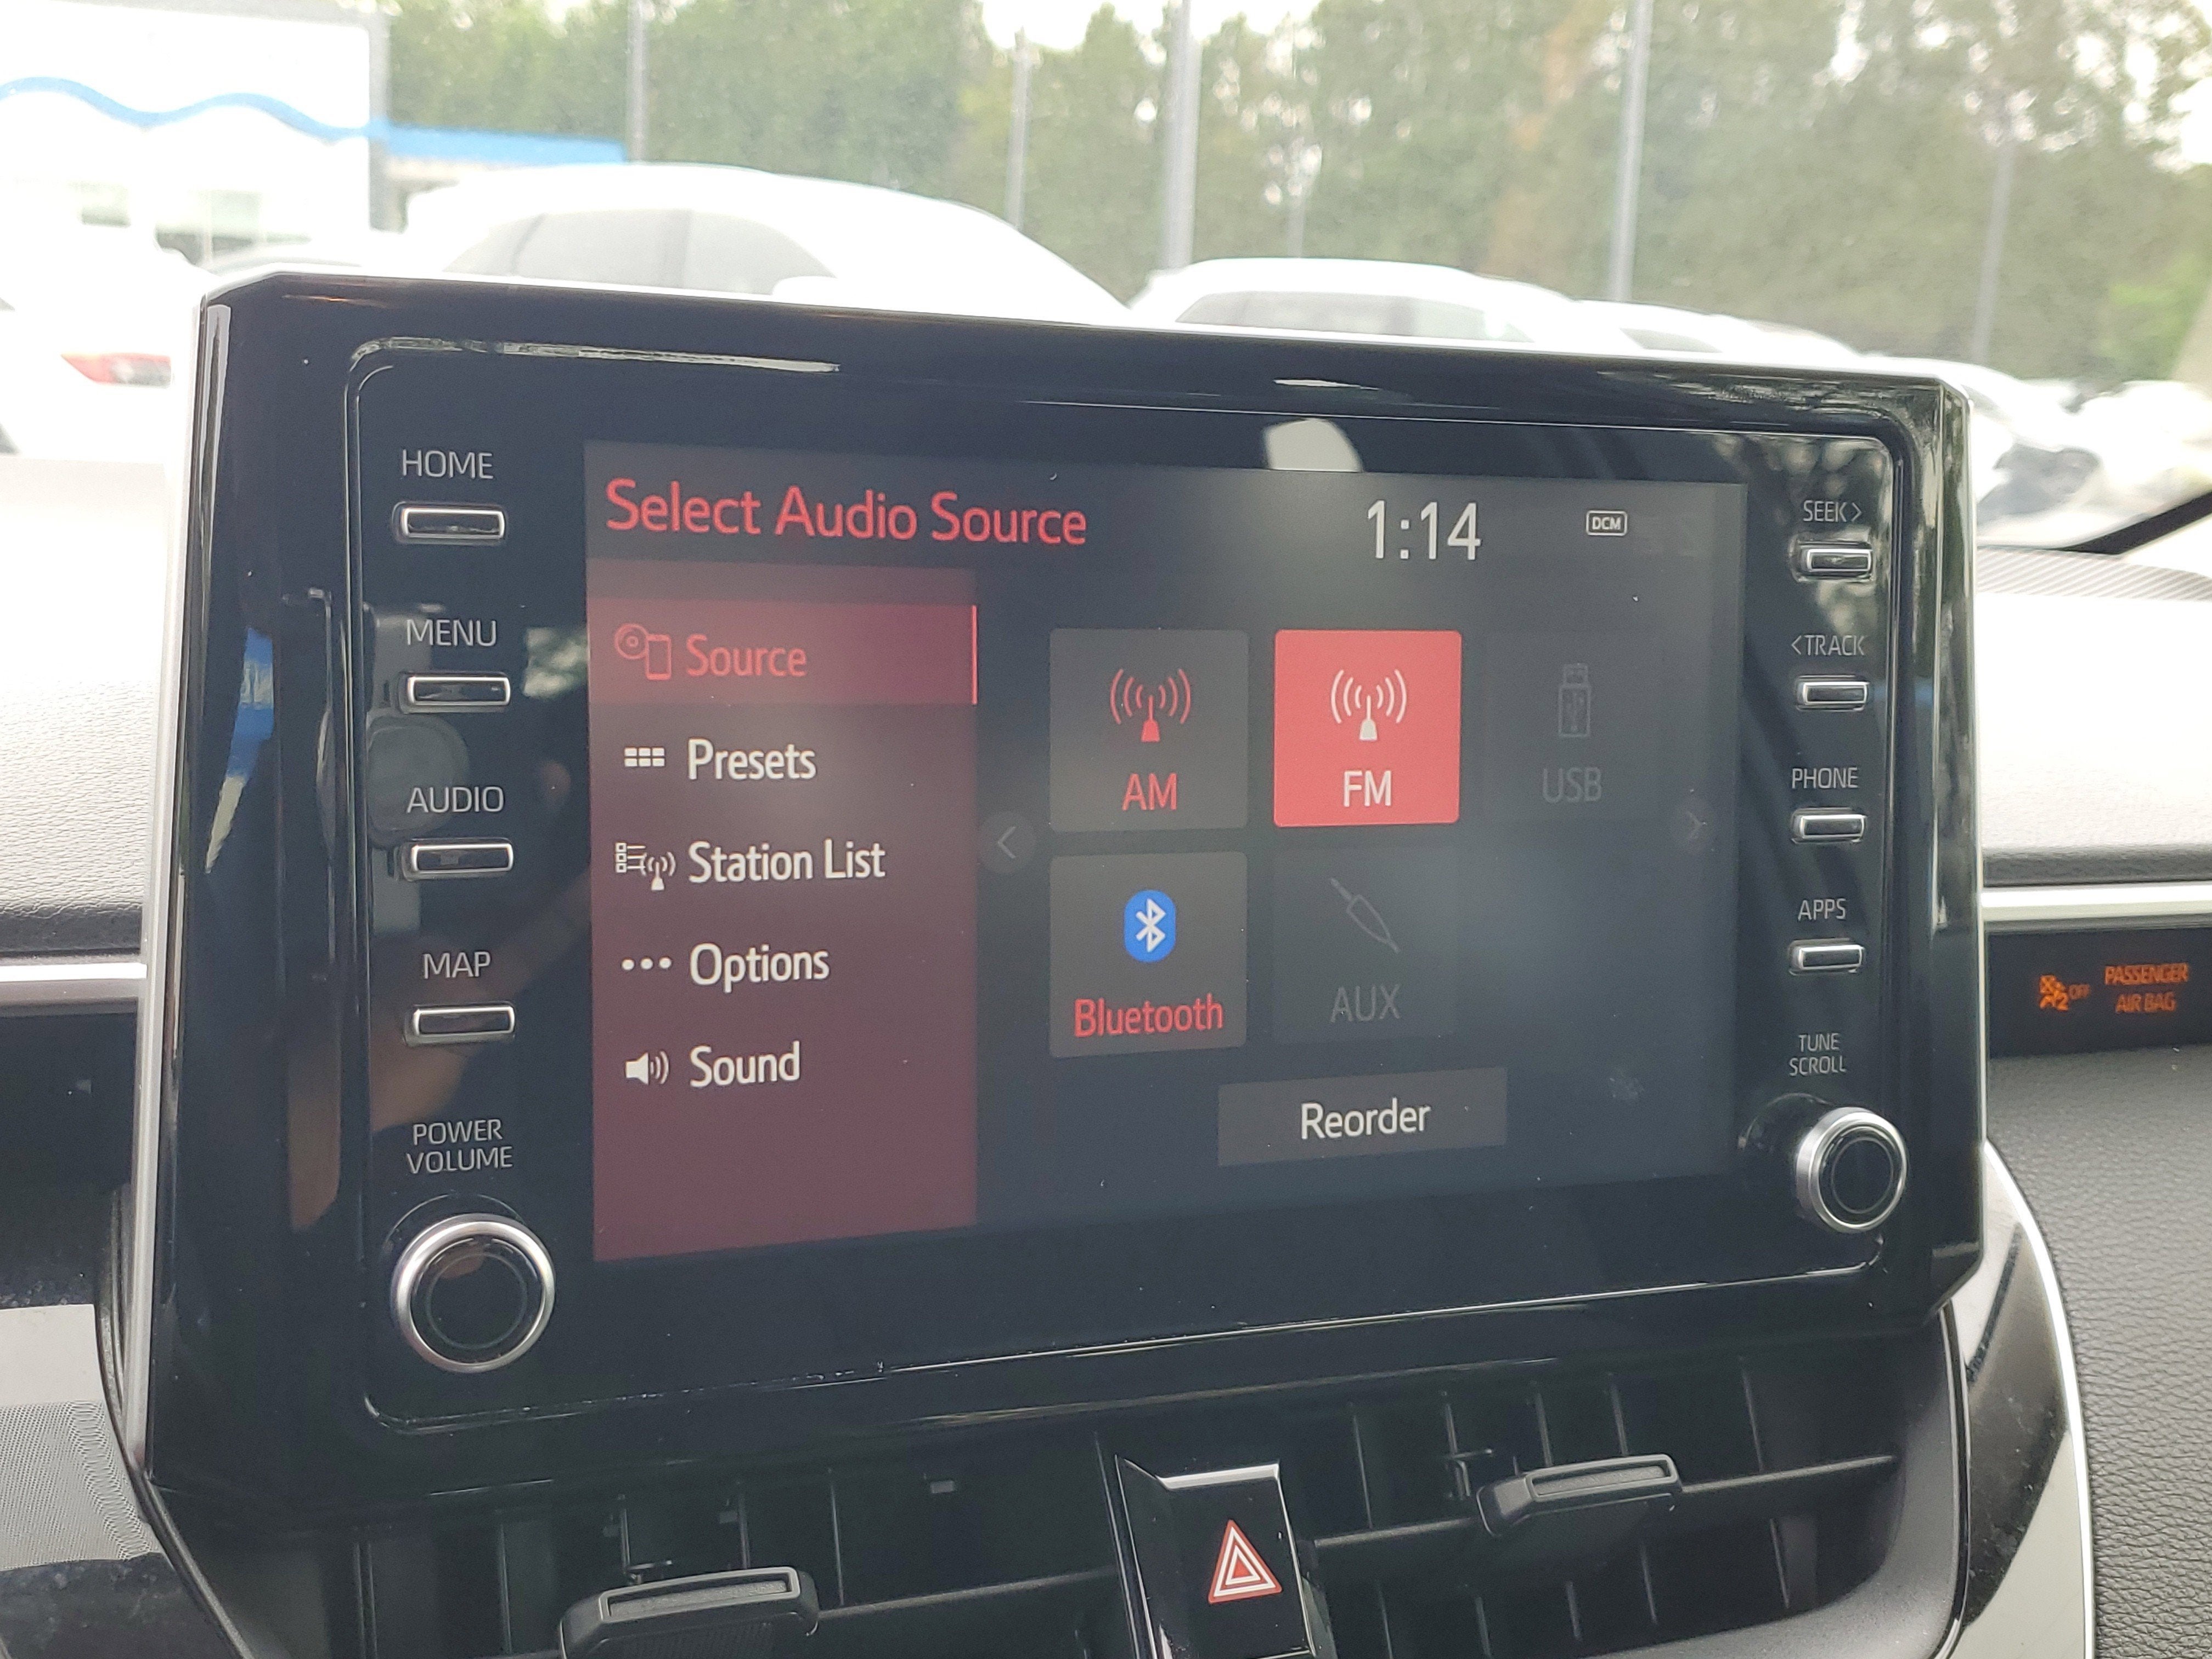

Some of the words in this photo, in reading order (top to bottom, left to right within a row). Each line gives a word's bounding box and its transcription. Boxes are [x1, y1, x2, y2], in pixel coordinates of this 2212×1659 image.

[401, 449, 494, 479] HOME
[606, 477, 761, 535] Select
[774, 485, 918, 541] Audio
[930, 490, 1088, 545] Source
[1592, 516, 1622, 531] DCM
[1803, 500, 1847, 522] SEEK
[1367, 499, 1481, 561] 1:14
[406, 618, 498, 646] MENU
[1804, 634, 1865, 656] TRACK
[686, 634, 808, 678] Source
[687, 737, 817, 781] Presets
[1121, 772, 1178, 811] AM
[1343, 770, 1393, 807] FM
[1542, 767, 1602, 803] USB
[1792, 767, 1859, 789] PHONE
[406, 786, 505, 814] AUDIO
[688, 841, 814, 883] Station
[823, 839, 886, 879] List
[1797, 898, 1848, 921] APPS
[422, 951, 492, 979] MAP
[689, 943, 830, 993] Options
[2104, 962, 2188, 985] PASSENGER
[1074, 994, 1223, 1038] Bluetooth
[1330, 984, 1402, 1023] AUX
[2116, 994, 2142, 1014] AIR
[2144, 991, 2176, 1012] BAG
[1798, 1032, 1841, 1052] TUNE
[689, 1040, 802, 1088] Sound
[1789, 1056, 1847, 1077] SCROLL
[413, 1118, 504, 1146] POWER
[1301, 1098, 1431, 1139] Reorder
[407, 1146, 514, 1174] VOLUME
